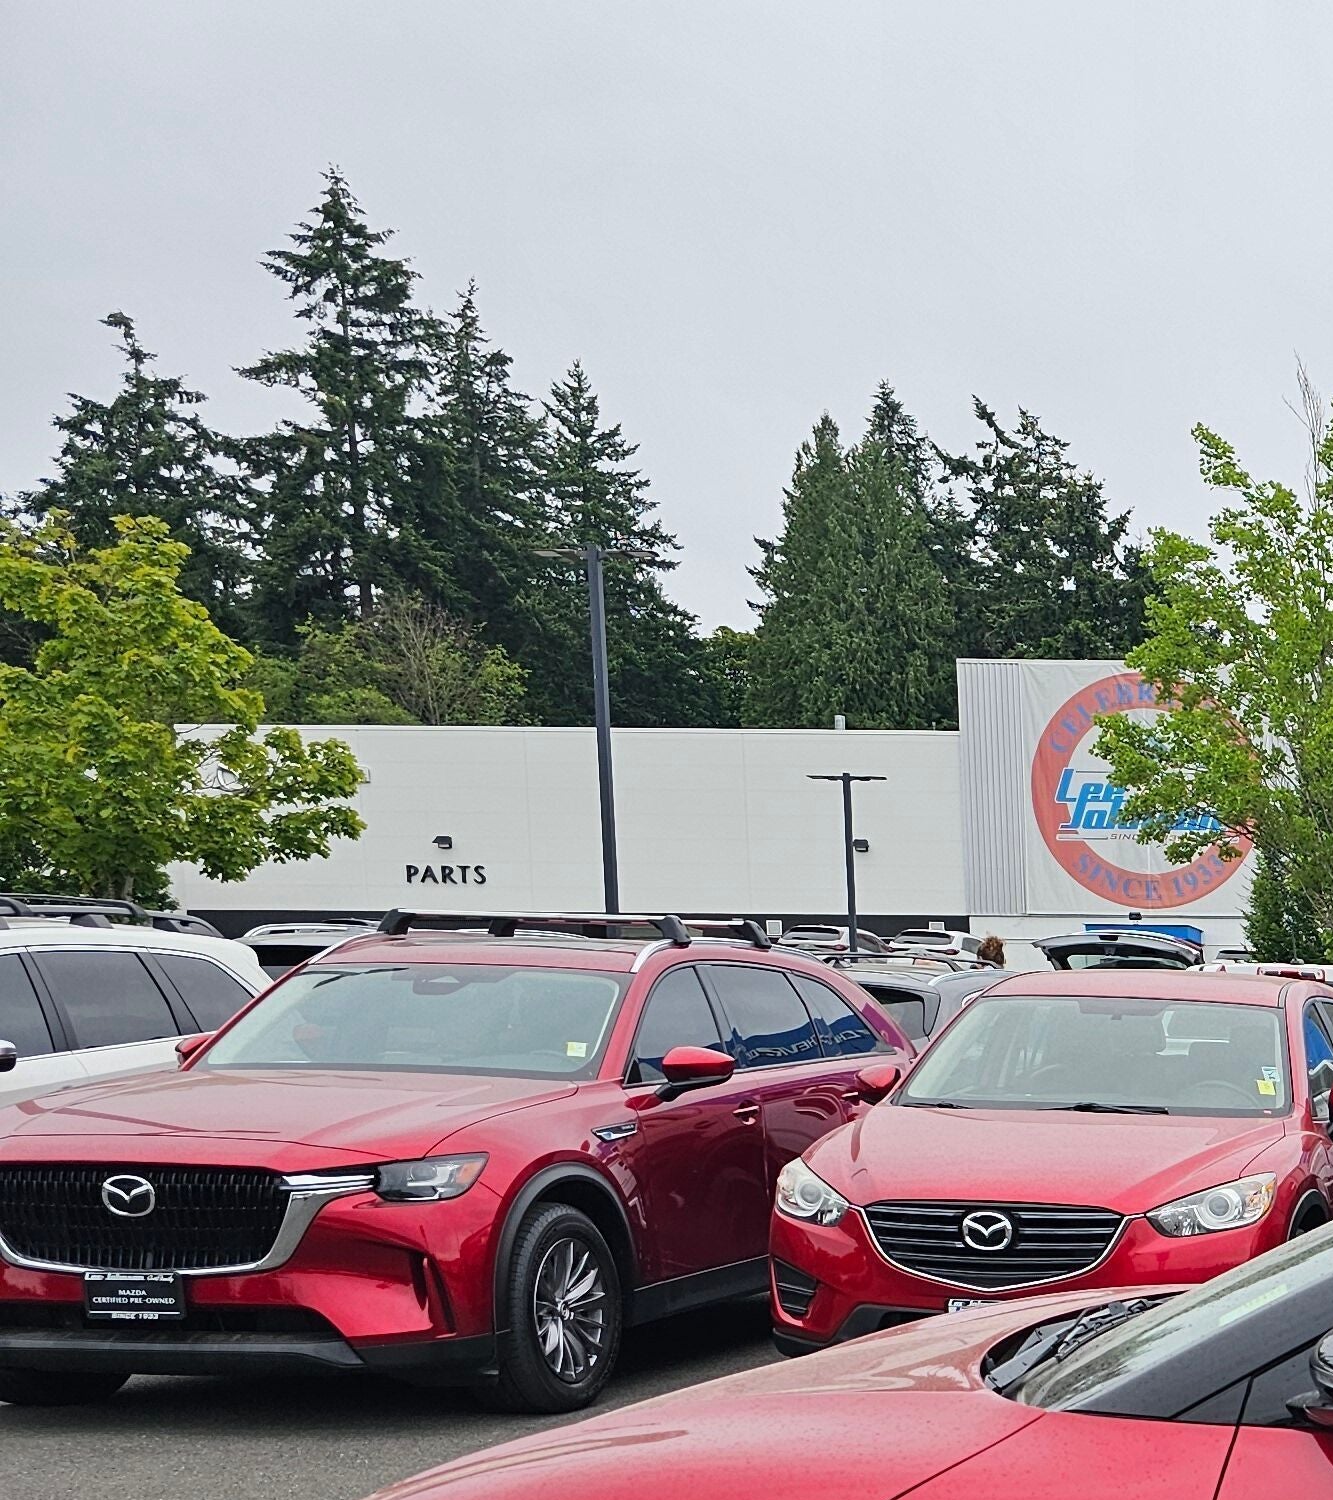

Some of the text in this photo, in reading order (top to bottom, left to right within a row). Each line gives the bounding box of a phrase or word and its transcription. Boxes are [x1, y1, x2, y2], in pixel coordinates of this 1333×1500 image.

[405, 864, 487, 885] PARTS
[1072, 853, 1224, 900] SINCE 1933
